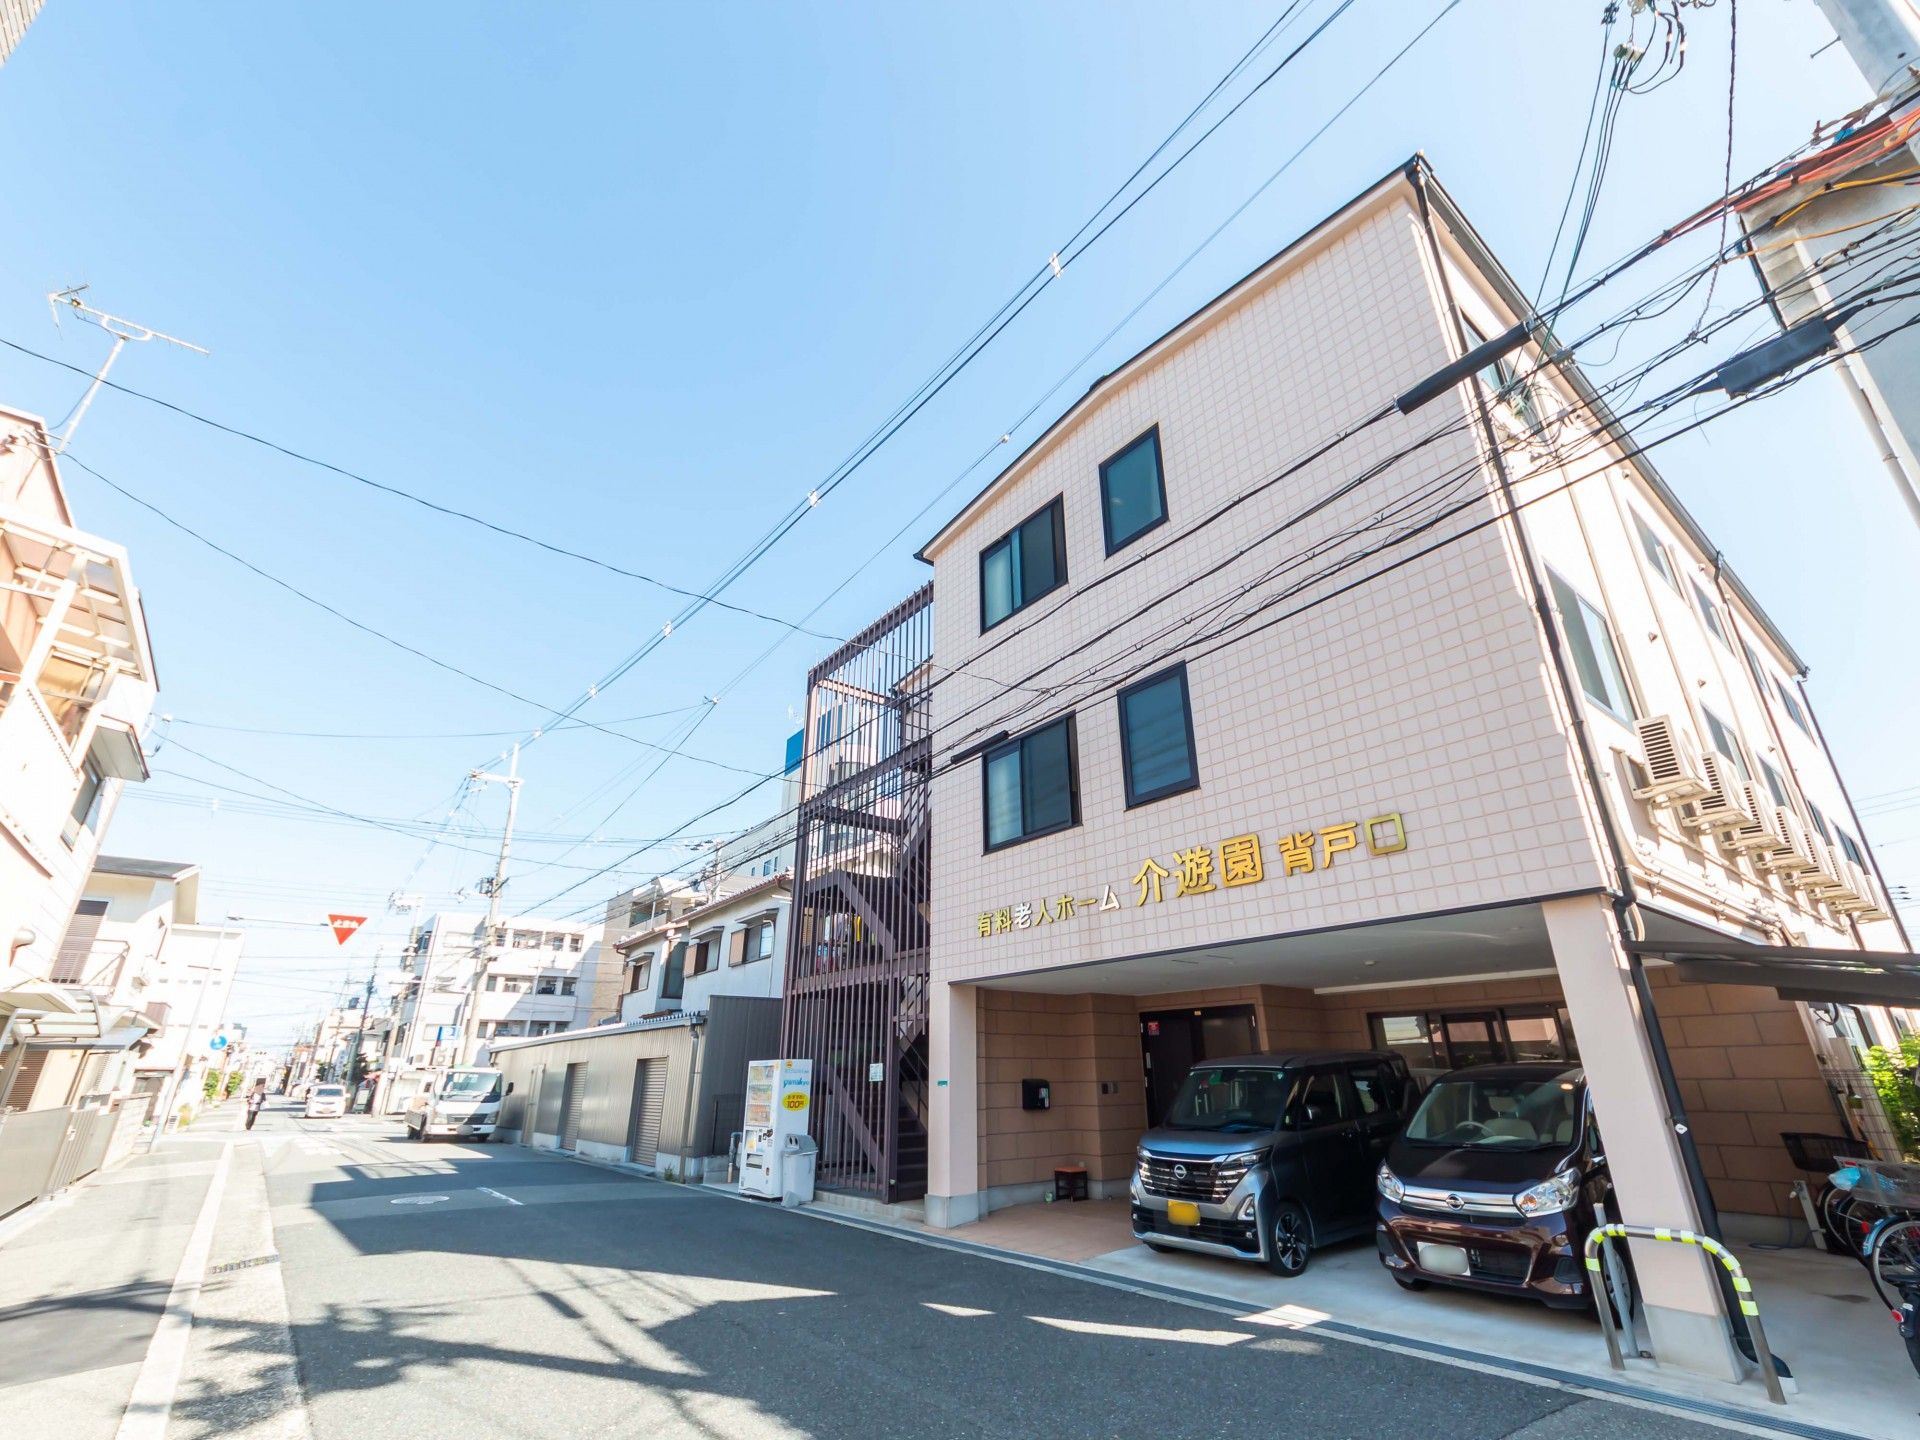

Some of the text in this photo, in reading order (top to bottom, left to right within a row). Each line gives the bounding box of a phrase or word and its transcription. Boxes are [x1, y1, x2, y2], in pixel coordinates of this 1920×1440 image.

[977, 811, 1407, 938] 有料老人ホーム 介遊園 背戸口
